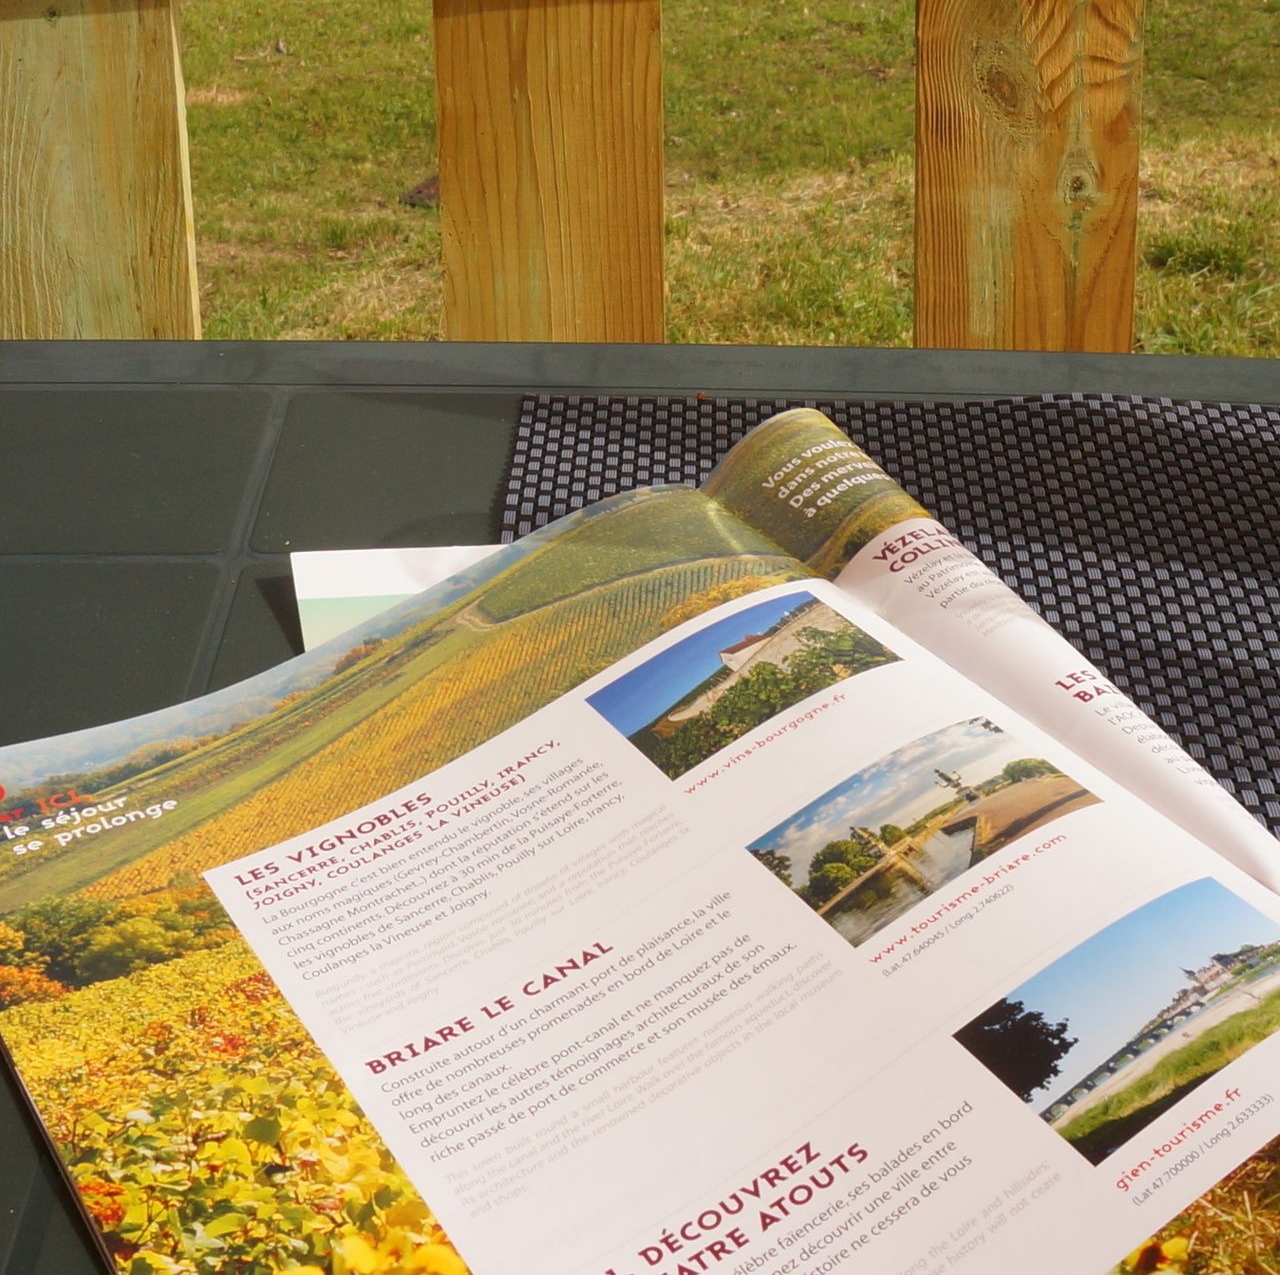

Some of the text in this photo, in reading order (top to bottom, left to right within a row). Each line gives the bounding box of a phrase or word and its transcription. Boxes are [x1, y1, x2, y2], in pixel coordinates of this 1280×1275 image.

[761, 457, 802, 488] Vous
[778, 467, 815, 499] dans
[789, 481, 821, 508] Des
[803, 507, 817, 518] à
[872, 527, 949, 561] VÉZELA
[939, 586, 969, 609] partie
[1055, 670, 1097, 691] LES
[684, 695, 845, 794] www.vins-bourgogne.fr
[3, 797, 128, 841] le séjour
[13, 798, 178, 856] se prolonge
[234, 792, 432, 886] LES VIGNOBLES
[262, 914, 279, 924] La
[279, 885, 348, 917] Bourgogne
[350, 871, 378, 888] c'est
[378, 858, 407, 874] bien
[408, 832, 458, 860] entendu
[457, 825, 468, 834] le
[523, 784, 542, 797] ses
[542, 758, 583, 785] villages
[278, 772, 609, 946] Chassagne dont la réputation s'étend sur les
[327, 830, 423, 879] COULANGES
[427, 819, 449, 832] LA
[451, 774, 526, 817] VINEUSE)
[272, 922, 294, 935] aux
[295, 907, 331, 924] noms
[332, 879, 392, 910] magiques
[287, 942, 316, 958] cinq
[384, 880, 449, 915] Découvrez
[450, 875, 459, 883] à
[459, 865, 475, 877] 30
[476, 853, 501, 869] min
[501, 843, 516, 855] de
[516, 836, 530, 845] la
[293, 958, 313, 970] les
[314, 931, 376, 960] vignobles
[377, 922, 393, 933] de
[496, 847, 536, 872] Pouilly
[537, 835, 555, 849] sur
[302, 949, 370, 981] Coulanges
[369, 943, 383, 952] la
[382, 919, 433, 945] Vineuse
[434, 911, 448, 921] et
[869, 835, 1066, 963] www.tourisme-briare.com
[365, 936, 614, 1074] BRIARE LE CANAL
[381, 1058, 451, 1093] Construite
[453, 1034, 495, 1061] autour
[498, 1018, 528, 1037] d'un
[529, 982, 590, 1020] charmant
[590, 965, 617, 987] port
[618, 954, 635, 967] de
[692, 909, 706, 919] la
[706, 892, 731, 910] ville
[391, 910, 731, 1107] offre de nombreuses promenades en bord de Loire et le
[409, 934, 751, 1134] Empruntez le célèbre pont-canal et ne manquez pas de
[398, 1064, 512, 1121] long des canaux.
[420, 944, 765, 1148] découvrir les autres témoignages architecturaux de son
[430, 1142, 465, 1163] riche
[467, 1120, 506, 1148] passé
[508, 1111, 526, 1124] de
[527, 1093, 558, 1116] port
[559, 1083, 576, 1096] de
[578, 1042, 646, 1085] commerce
[647, 1032, 661, 1044] et
[662, 1017, 686, 1034] son
[686, 989, 728, 1018] musée
[729, 973, 752, 990] des
[847, 1181, 871, 1198] ses
[867, 1142, 922, 1183] balades
[922, 1128, 941, 1144] en
[937, 1100, 973, 1130] bord
[1116, 1088, 1241, 1192] gien-tourisme.fr
[1132, 1188, 1153, 1206] (Lat
[1203, 1128, 1232, 1149] Long
[638, 1142, 821, 1266] DÉCOUVREZ
[677, 1143, 868, 1275] ATRE ATOUTS
[799, 1141, 957, 1262] découvrir une ville entre
[850, 1155, 972, 1251] ne cessera de vous
